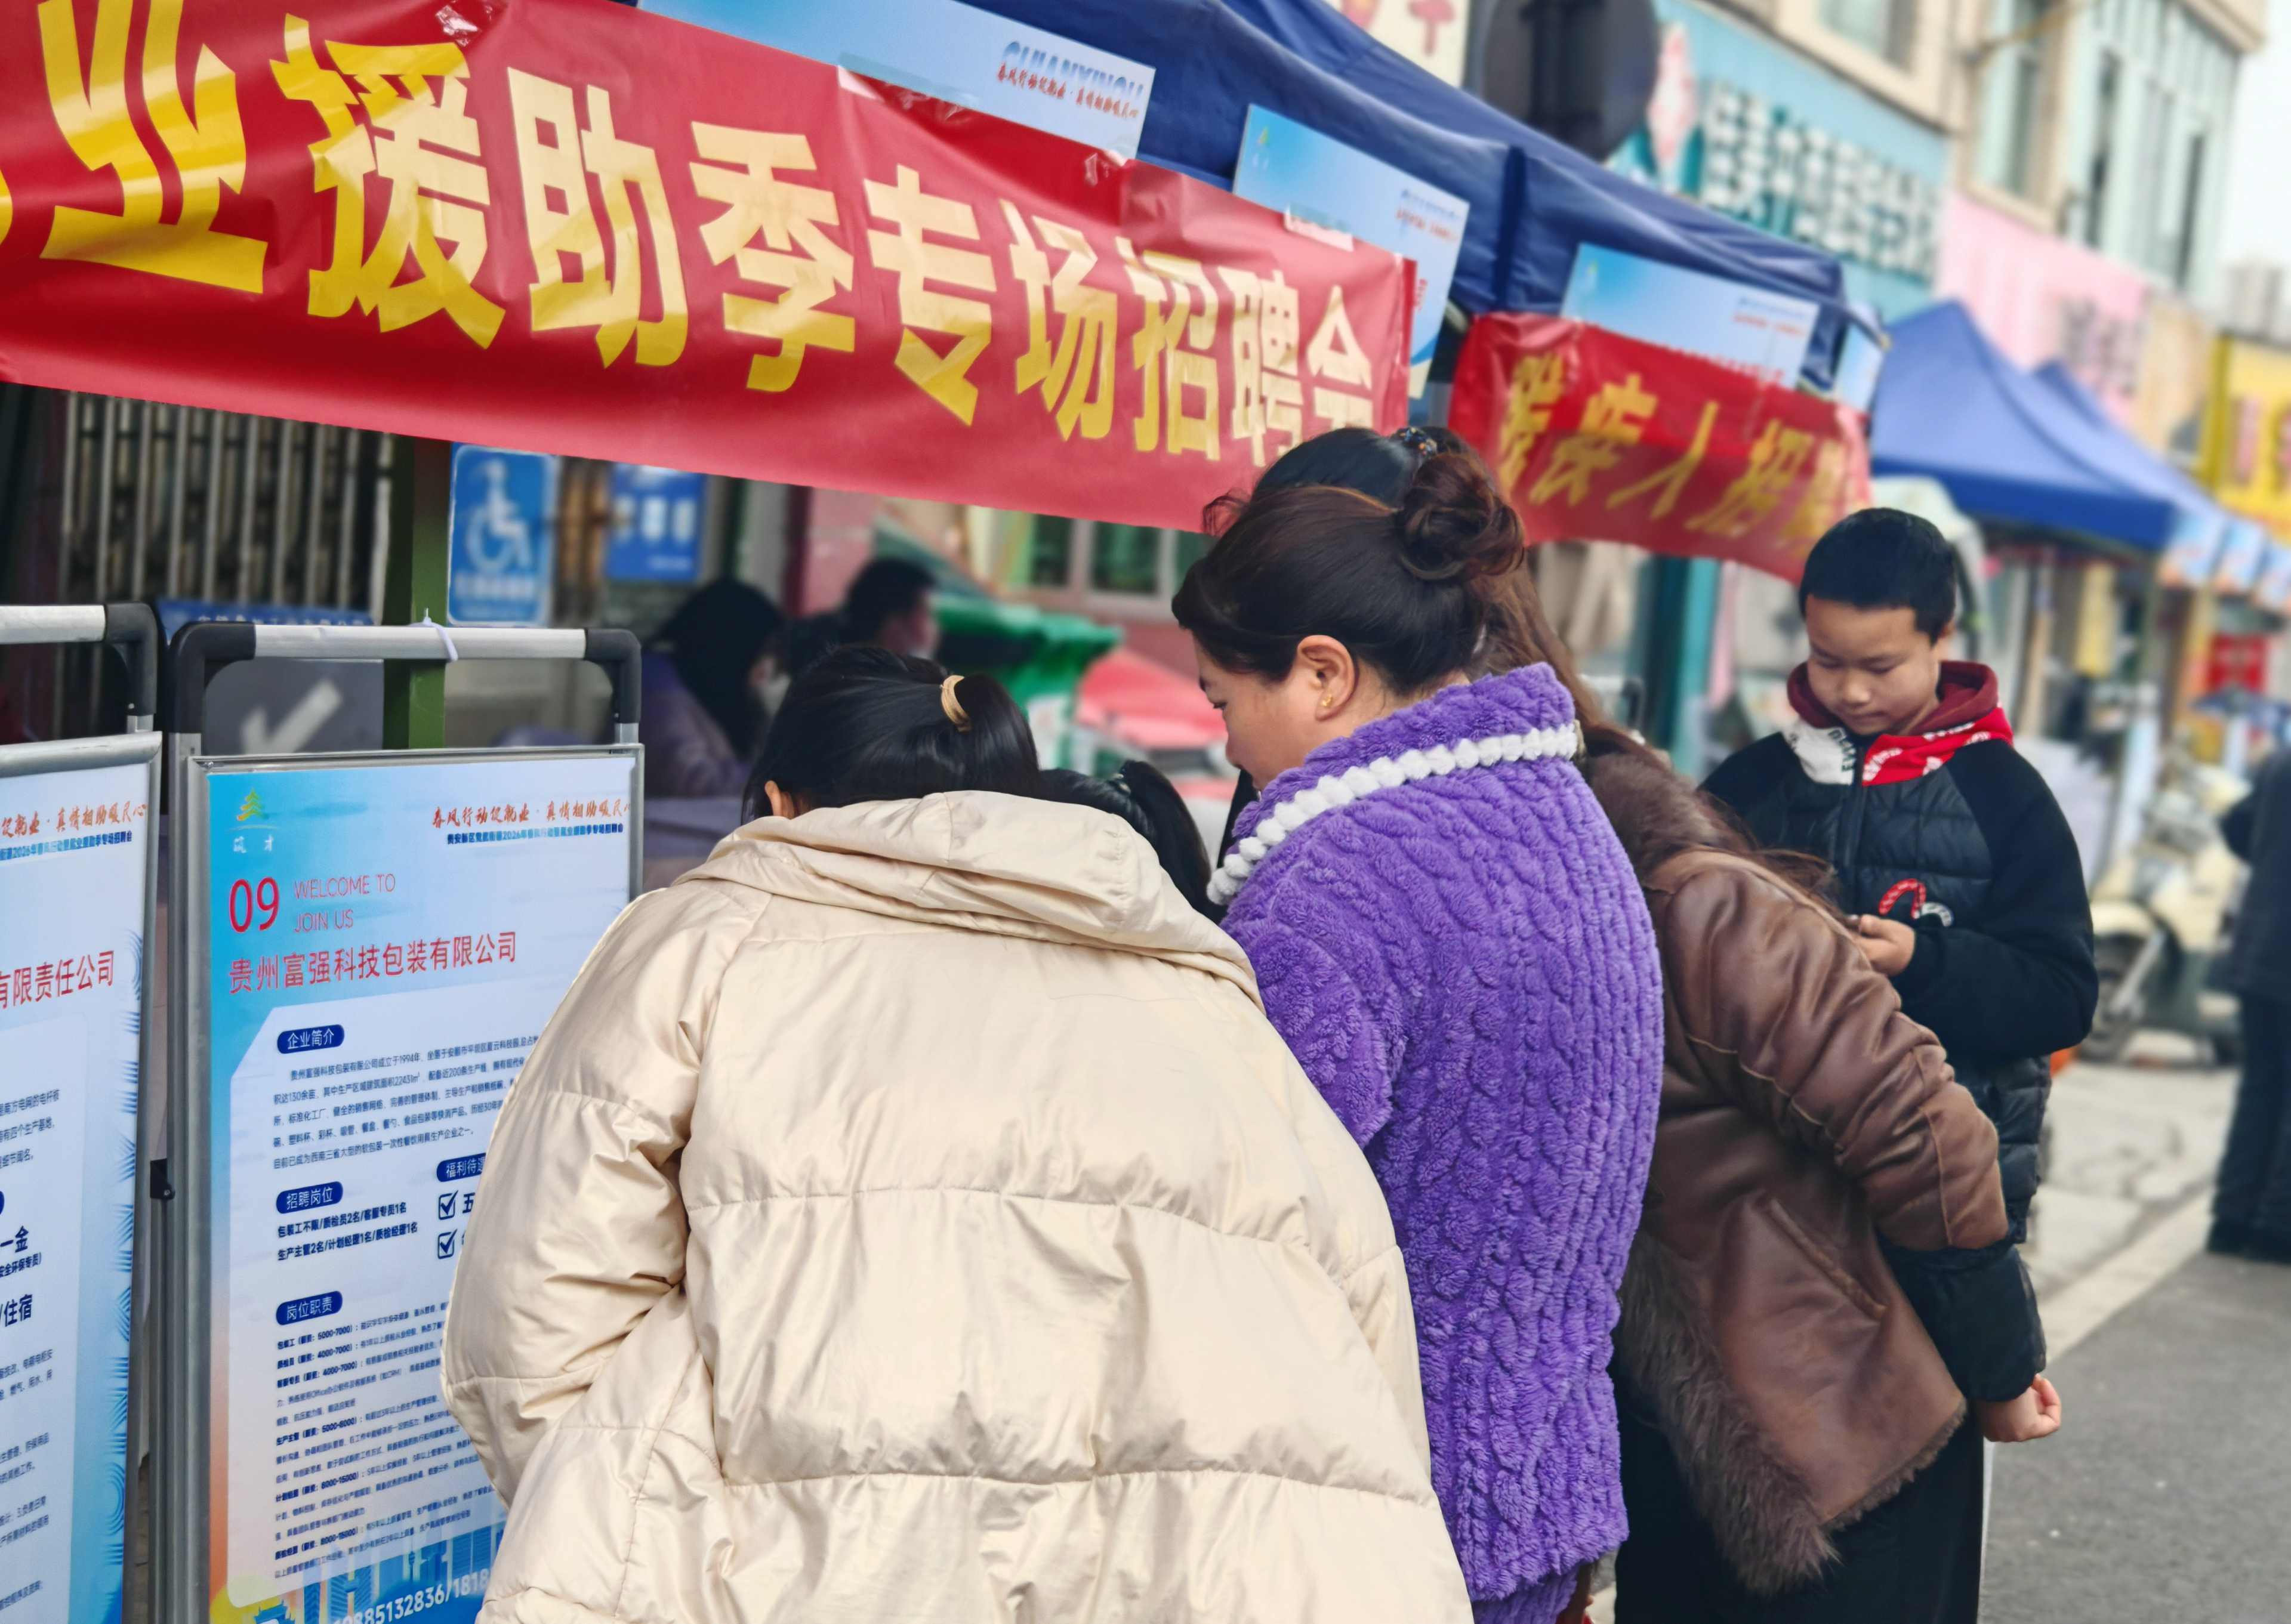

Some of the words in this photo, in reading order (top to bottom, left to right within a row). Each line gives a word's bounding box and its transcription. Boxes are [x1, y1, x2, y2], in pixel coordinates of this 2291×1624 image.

[0, 0, 1373, 468] 业援助季专场招聘会
[294, 876, 370, 900] WELCOME
[375, 873, 396, 893] TO
[229, 877, 280, 933] 09
[294, 913, 329, 933] JOIN
[334, 909, 354, 928] US
[229, 931, 517, 995] 贵州富强科技包装有限公司
[287, 1028, 334, 1049] 企业简介
[287, 1185, 334, 1210] 招聘岗位
[286, 1296, 332, 1320] 岗位职责
